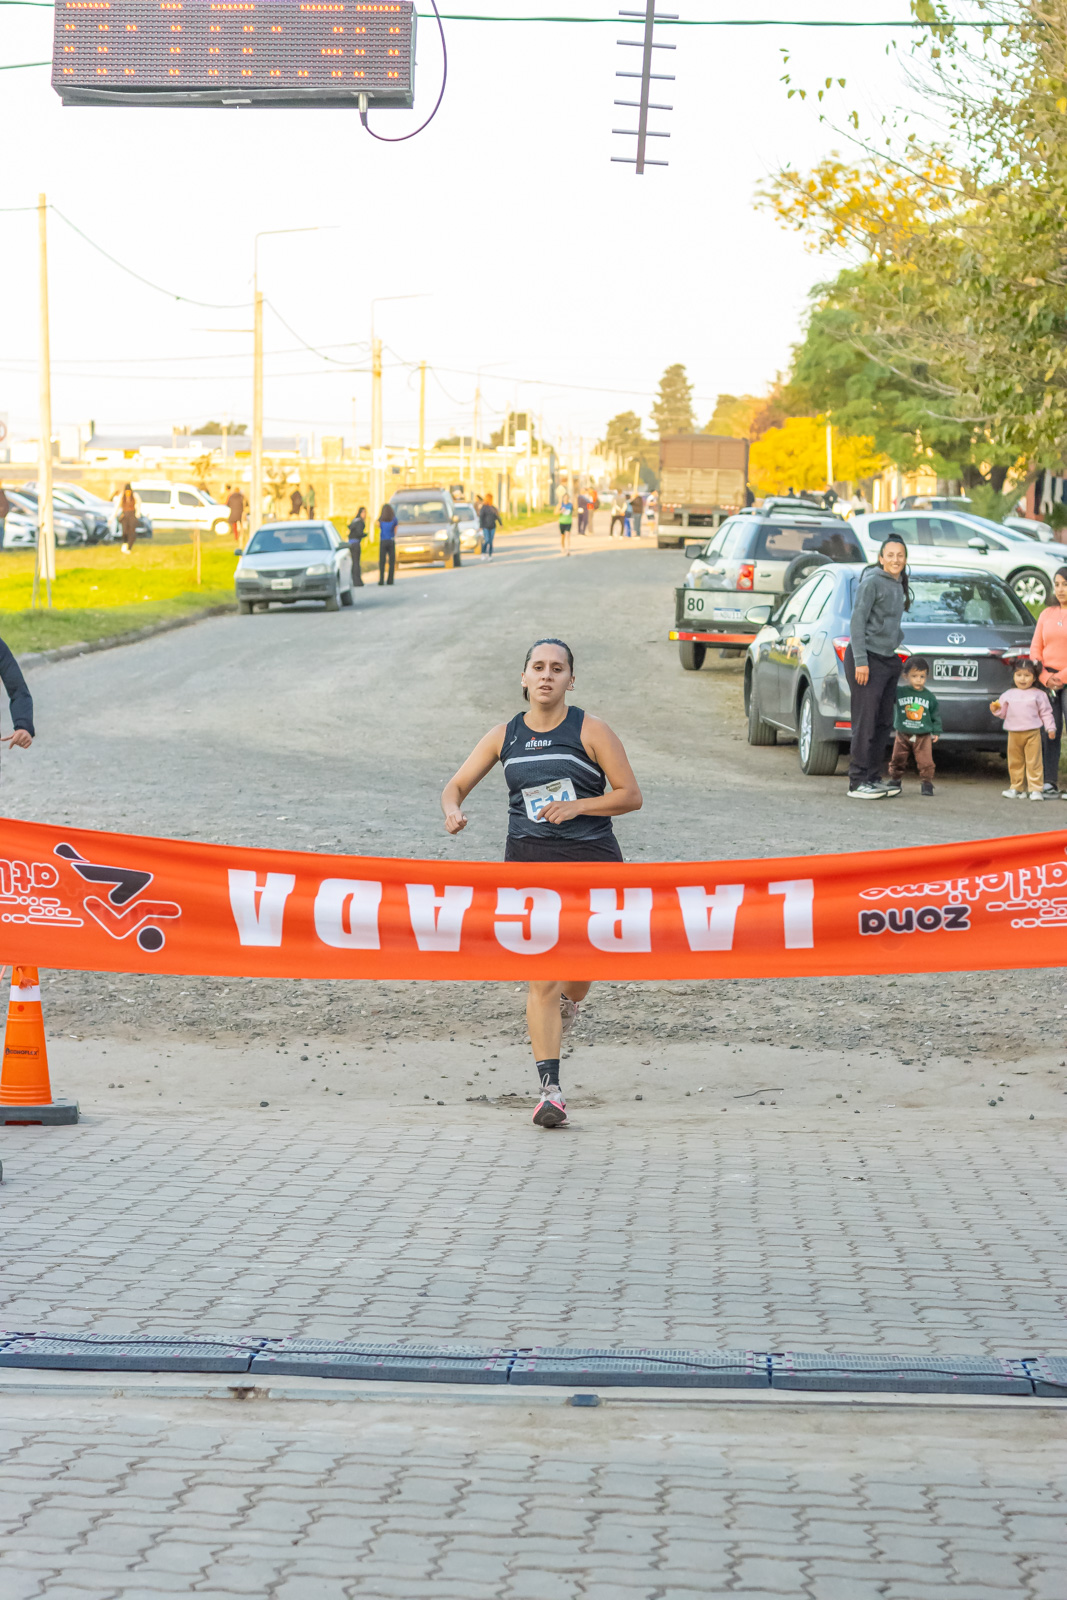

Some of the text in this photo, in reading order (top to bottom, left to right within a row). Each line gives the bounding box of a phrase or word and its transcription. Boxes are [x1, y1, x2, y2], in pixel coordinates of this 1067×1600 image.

[687, 597, 704, 612] 80
[935, 664, 977, 677] PKT 477
[525, 739, 552, 747] ATENAS
[530, 790, 571, 820] 54
[228, 868, 815, 955] LARGADA
[858, 904, 971, 936] zona
